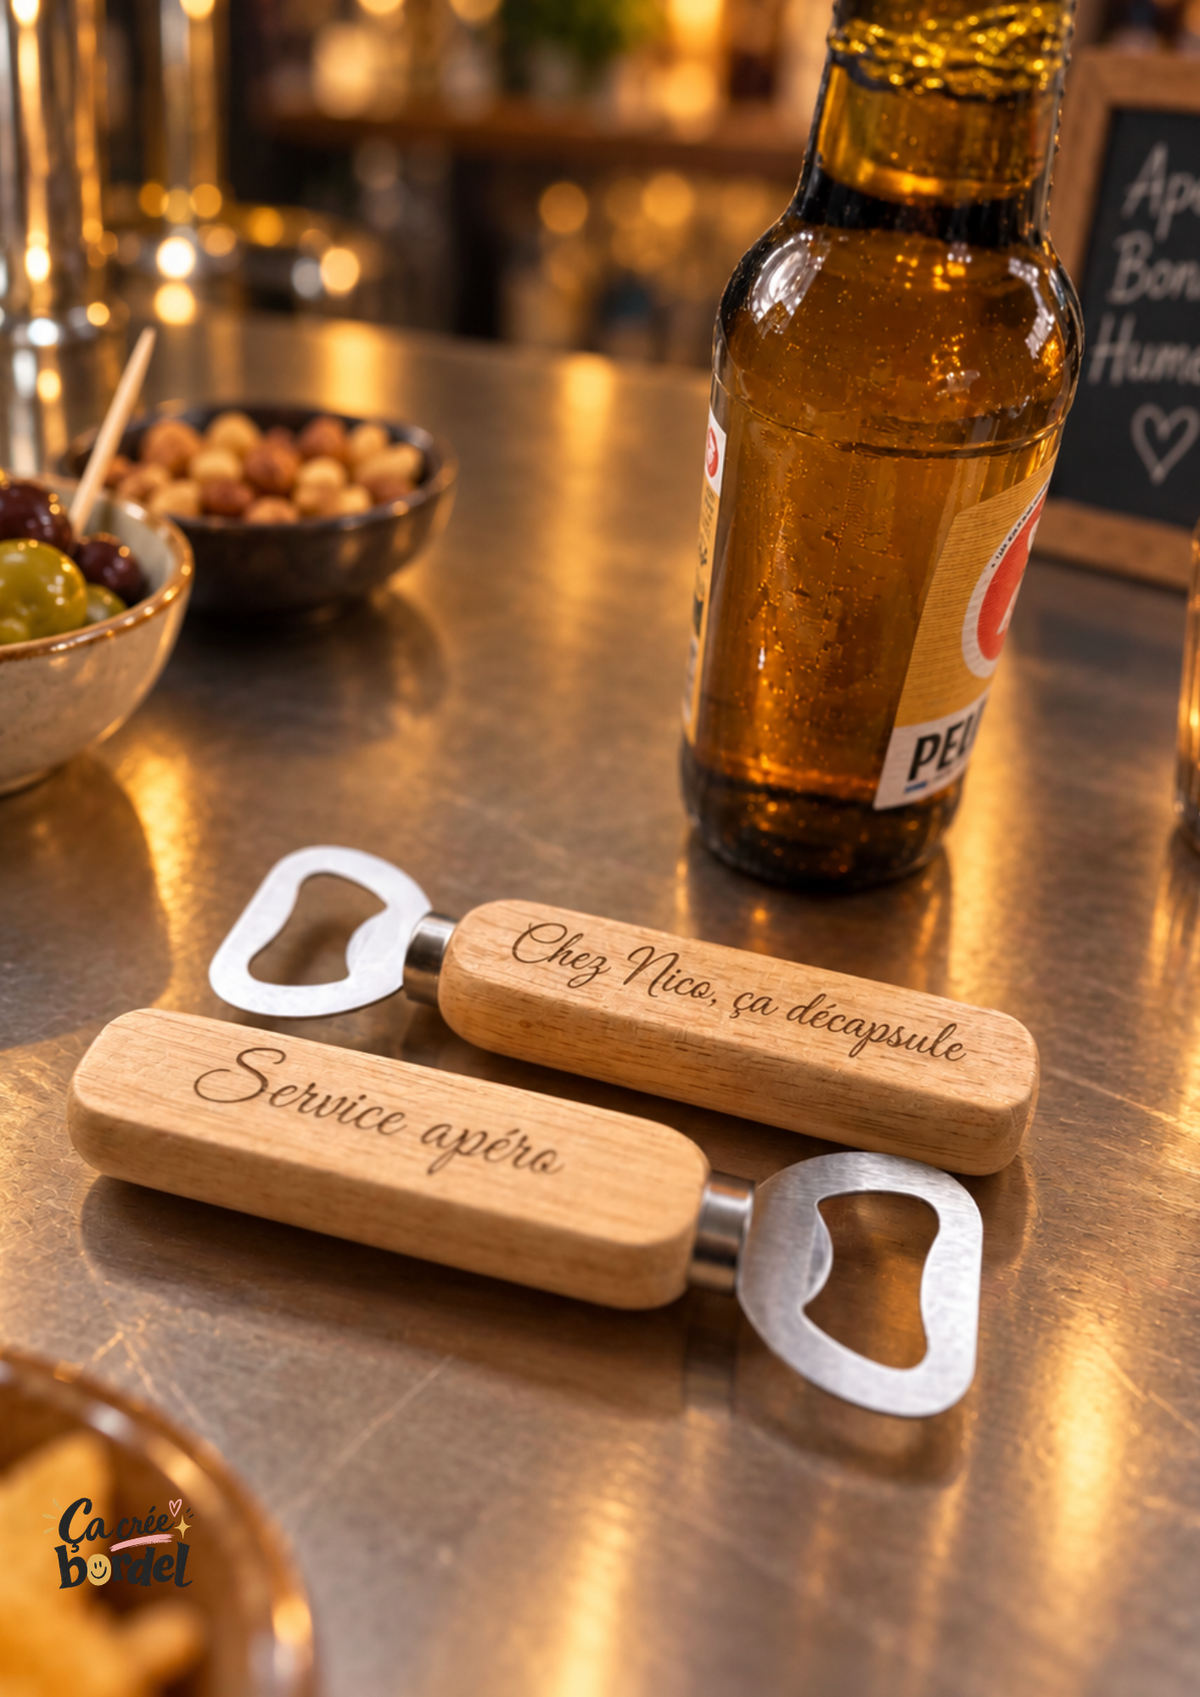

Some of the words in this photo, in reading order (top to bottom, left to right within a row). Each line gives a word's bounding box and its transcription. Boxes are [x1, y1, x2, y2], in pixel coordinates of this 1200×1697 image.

[511, 922, 612, 989] Chez
[622, 945, 719, 1007] Nico,
[730, 990, 778, 1020] ça
[785, 992, 967, 1062] décapsule
[193, 1047, 407, 1137] Service
[420, 1122, 564, 1176] apéro
